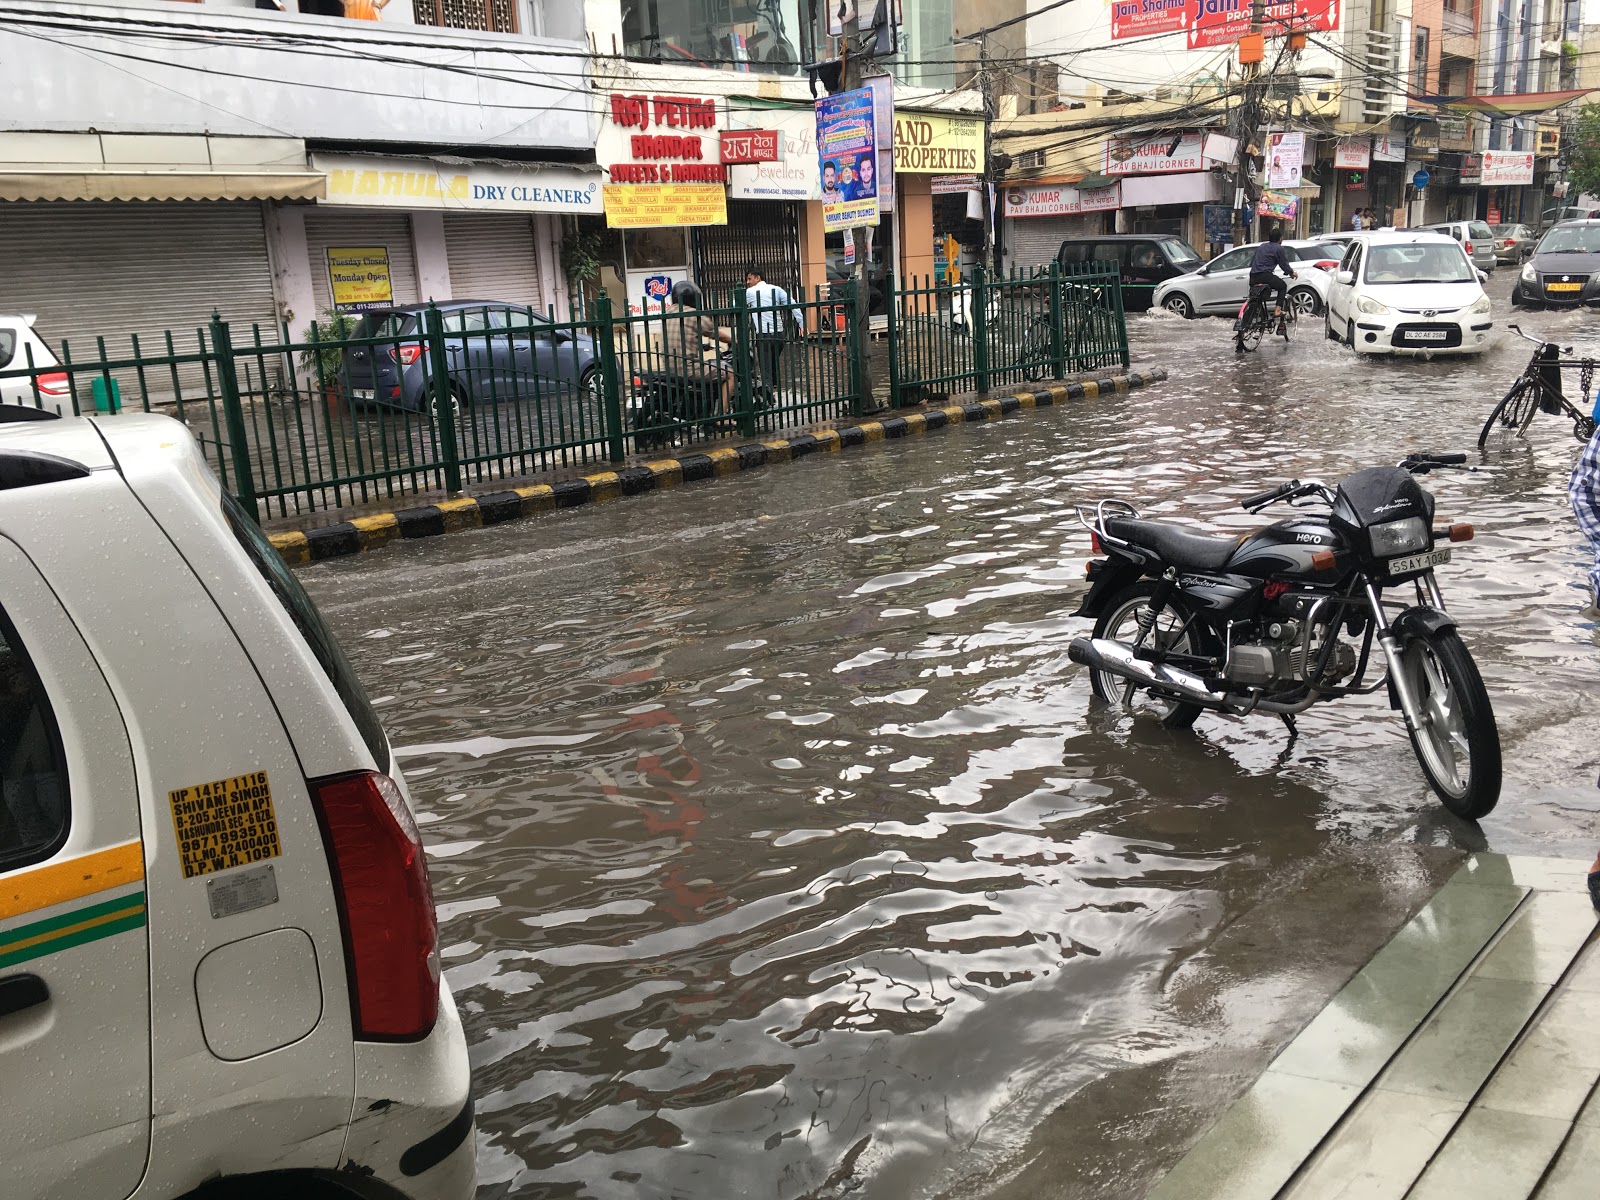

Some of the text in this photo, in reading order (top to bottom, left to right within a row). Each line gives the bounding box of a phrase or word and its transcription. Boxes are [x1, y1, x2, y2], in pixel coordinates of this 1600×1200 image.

[1116, 2, 1138, 20] Jain
[1131, 10, 1168, 22] PROPERTIES
[1226, 3, 1298, 22] PRORTIES
[1202, 28, 1226, 36] Property
[610, 94, 716, 131] RAJ PETHA
[631, 135, 703, 160] BHANDAR
[723, 137, 753, 159] राज
[754, 133, 774, 147] पेठा
[753, 148, 774, 158] भण्डार
[895, 146, 977, 170] PROPERTIES
[609, 164, 659, 184] SWEETS
[660, 164, 673, 183] &
[751, 160, 805, 182] Jewellers
[1114, 159, 1195, 171] PAV BHAJI CORNER
[329, 169, 592, 205] NARULA DRY CLEANERS
[1029, 191, 1060, 204] KUMAR
[1010, 206, 1024, 215] PAV
[1025, 204, 1048, 214] BHAJI
[1048, 202, 1080, 213] CORNER
[331, 256, 387, 267] Tuesday Closed
[334, 272, 387, 283] Monday Open
[648, 278, 668, 296] Raj
[172, 772, 266, 803] UP 14 FT 1116
[174, 784, 269, 816] SHIVANI SINGH
[177, 796, 270, 829] B-205 JEEVAN APT
[178, 819, 228, 842] VASHUNDRA
[228, 815, 244, 829] SEC
[256, 808, 273, 823] GZB.
[182, 821, 276, 853] 9871993510
[185, 844, 279, 878] D.P.W.H. 1091
